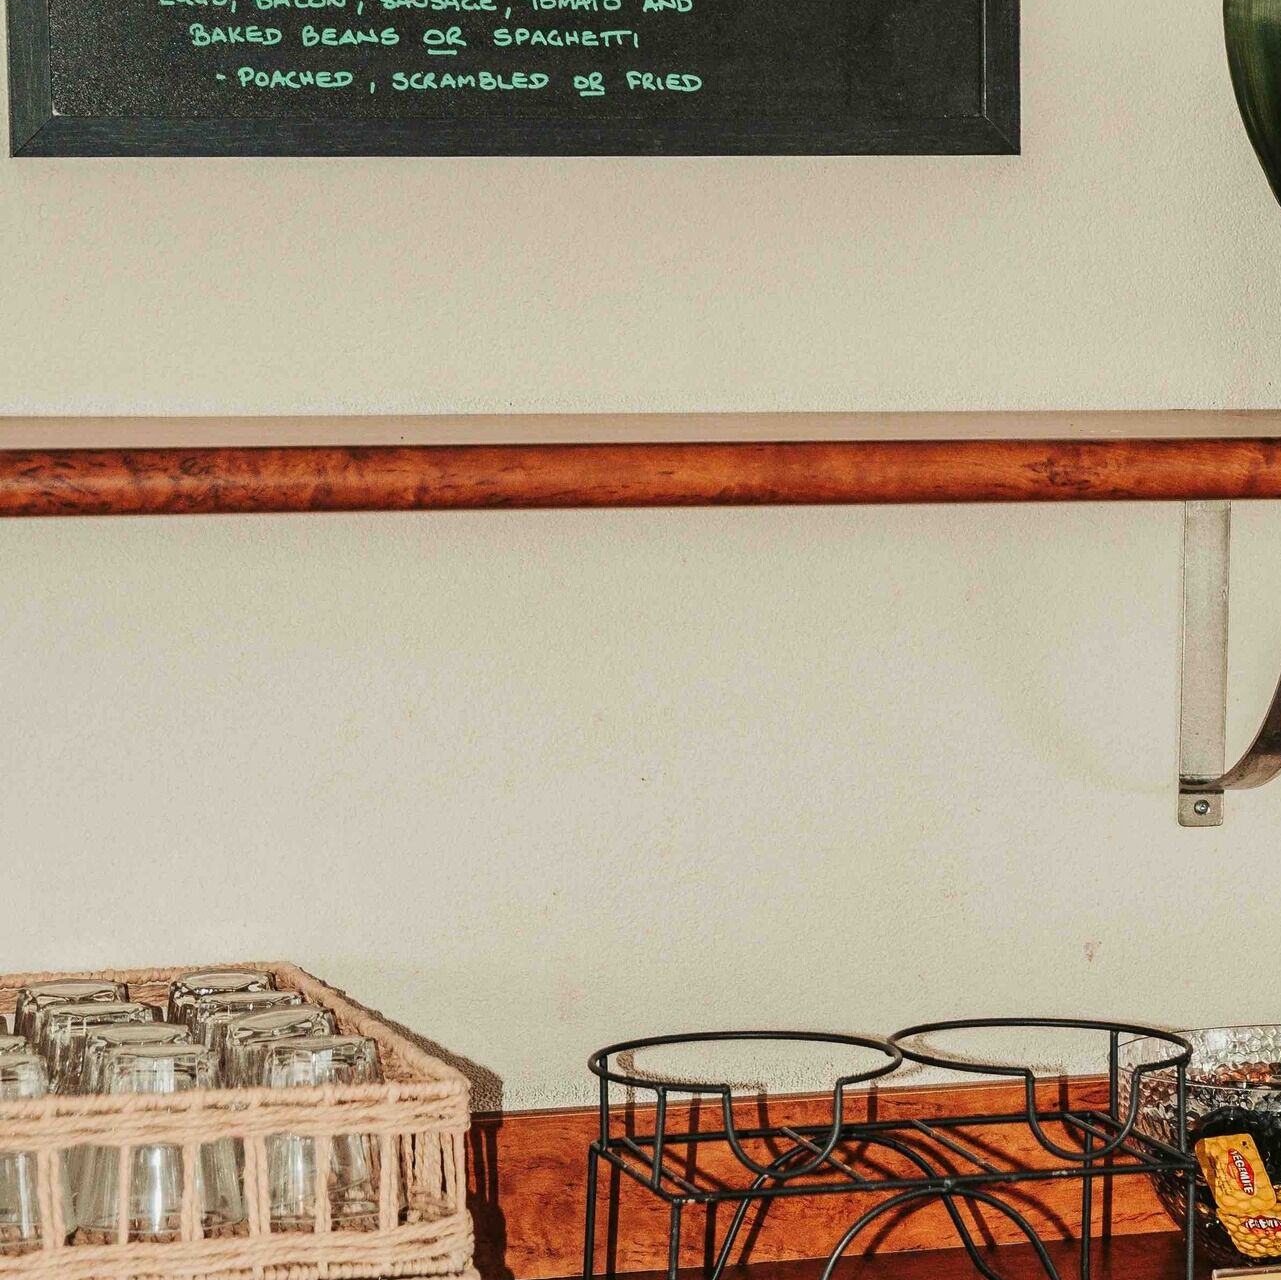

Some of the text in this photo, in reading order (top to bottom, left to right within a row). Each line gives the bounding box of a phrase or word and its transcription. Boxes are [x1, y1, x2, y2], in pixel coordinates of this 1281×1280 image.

[189, 23, 638, 48] BAKED BEANS OR SPAGHETTI
[392, 71, 549, 90] SCRAMBLED
[574, 72, 605, 95] OR
[626, 71, 702, 92] FRIED
